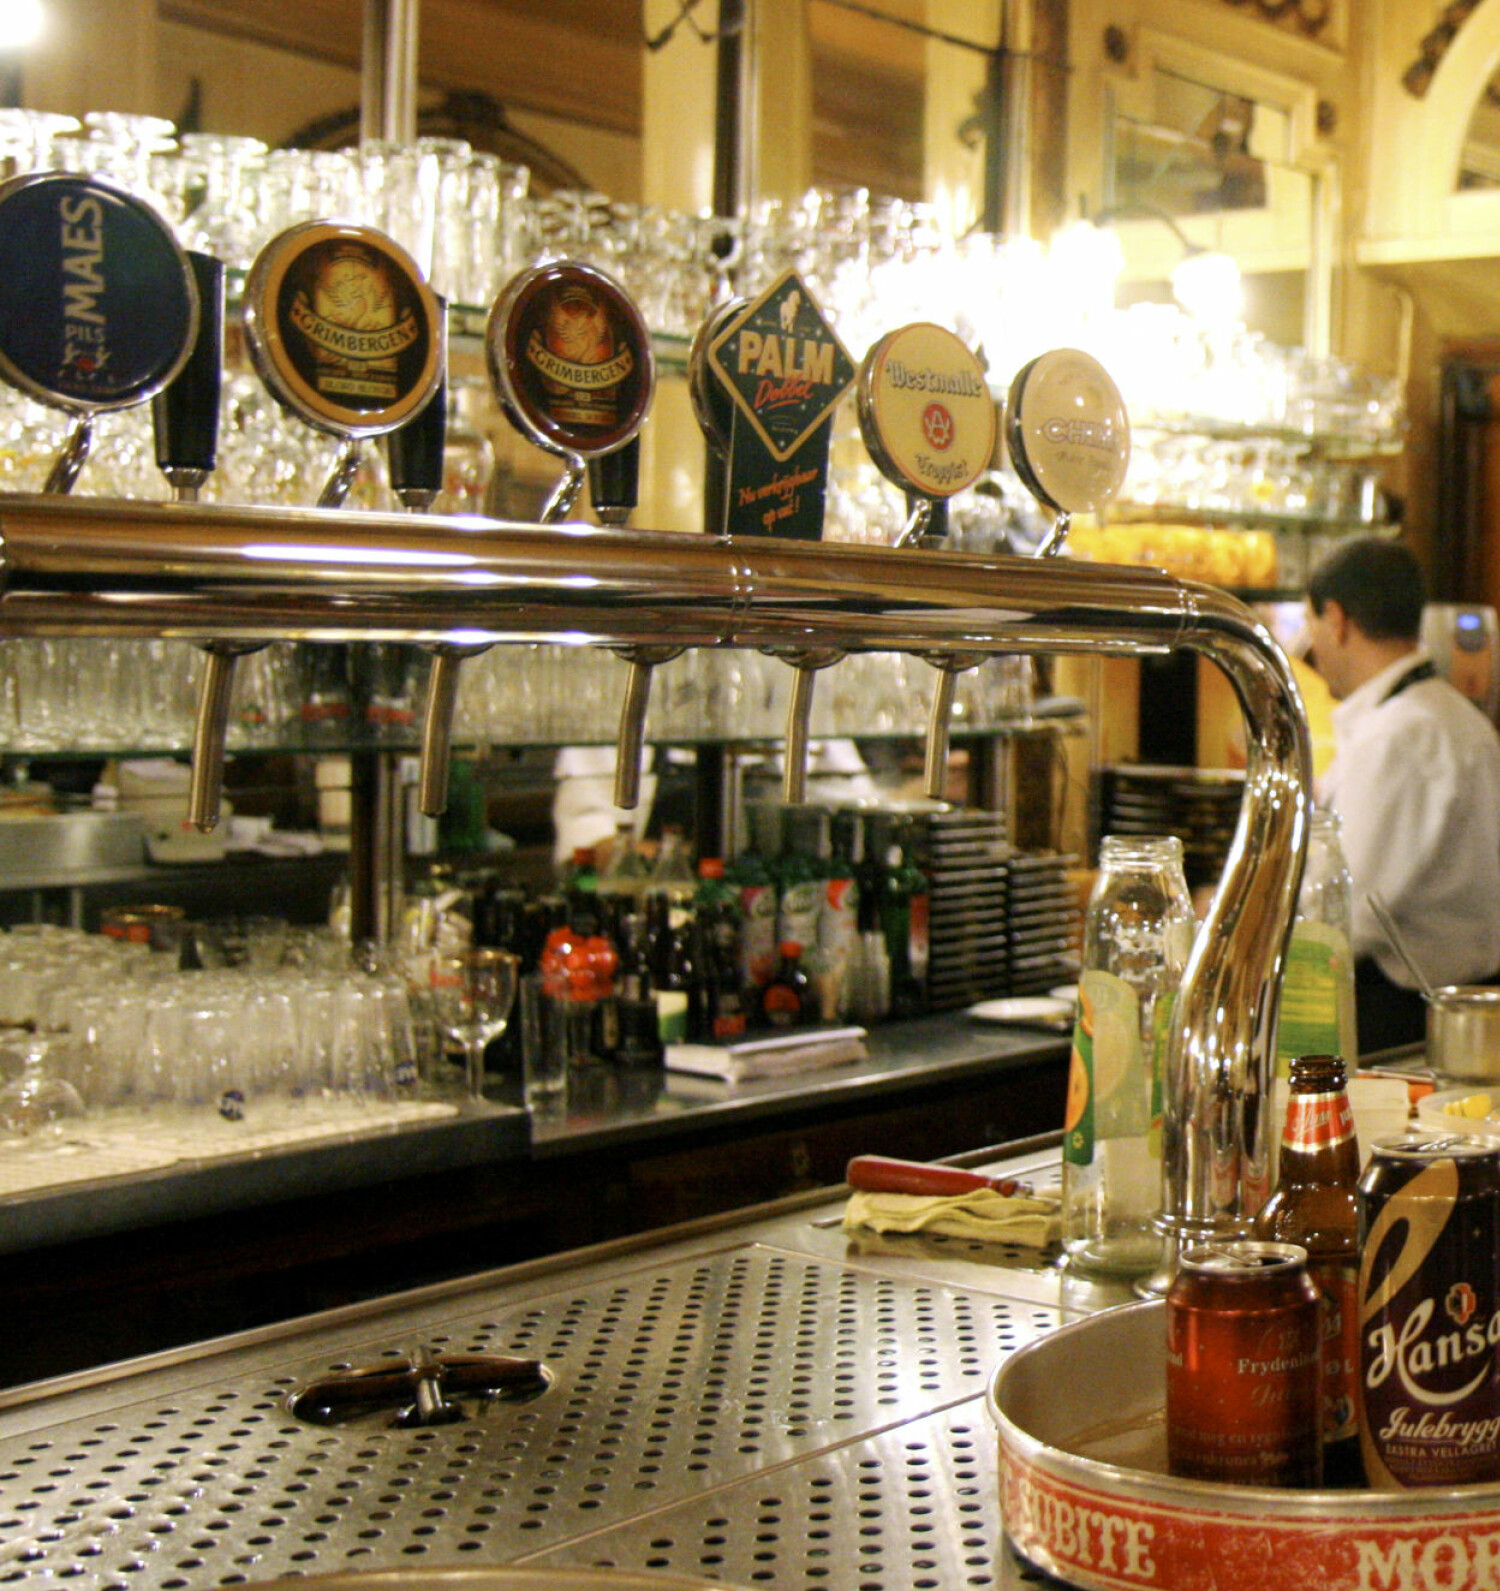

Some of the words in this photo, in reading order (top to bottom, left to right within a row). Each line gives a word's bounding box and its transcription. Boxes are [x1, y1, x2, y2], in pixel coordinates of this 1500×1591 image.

[60, 195, 105, 325] MAES
[65, 323, 105, 344] PILS
[301, 312, 411, 352] GRIMBERGEN
[535, 350, 627, 385] GRIMBERGEN
[738, 329, 835, 385] PALM
[754, 372, 815, 409] Dobbel
[885, 360, 982, 398] Westmalle
